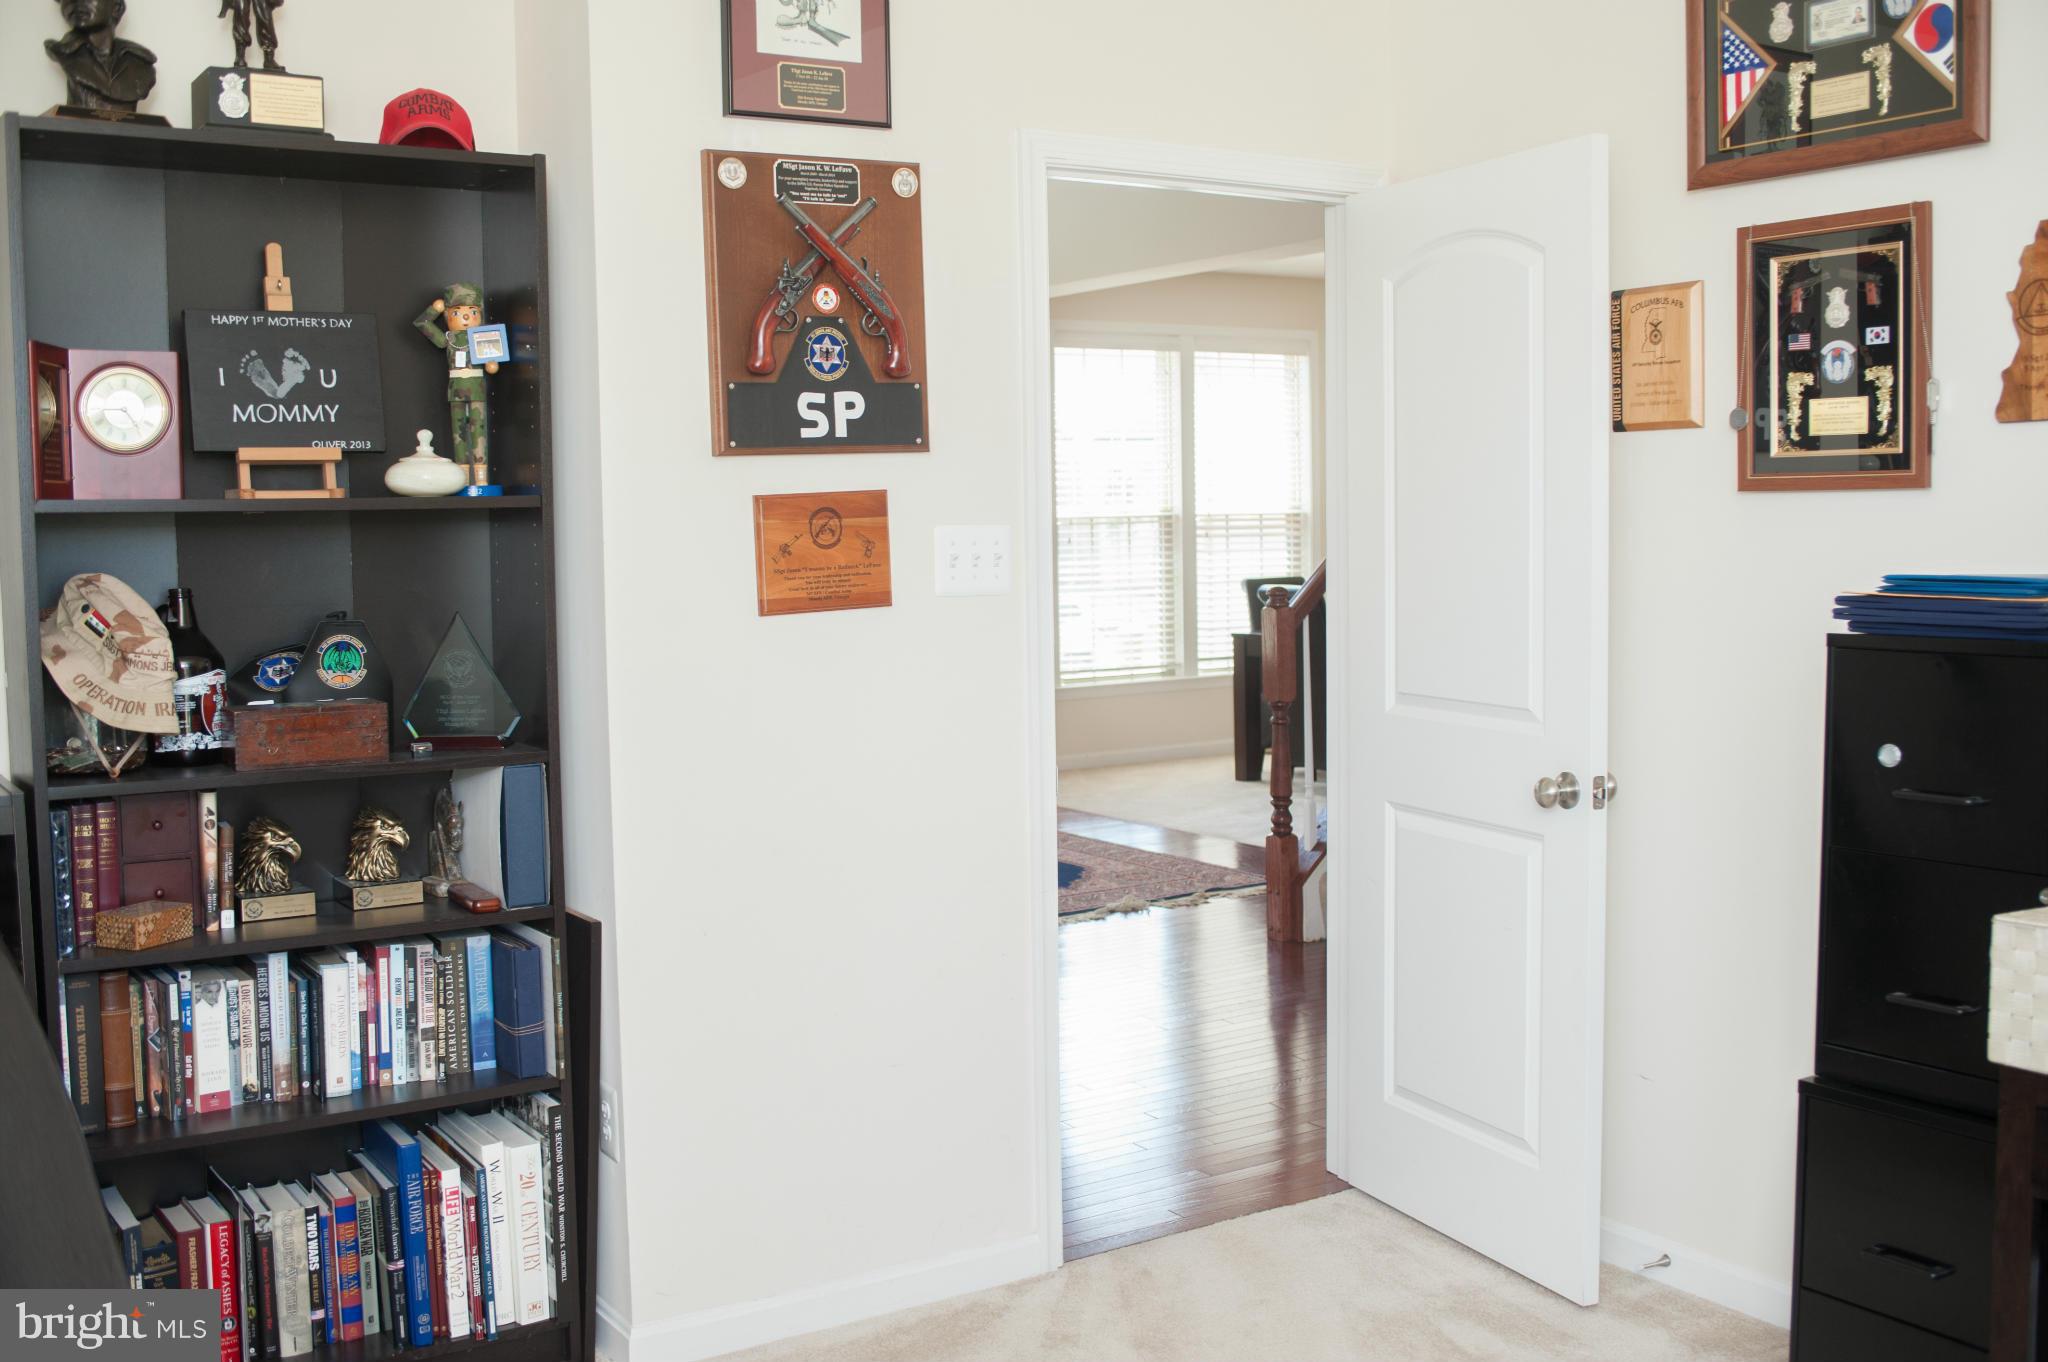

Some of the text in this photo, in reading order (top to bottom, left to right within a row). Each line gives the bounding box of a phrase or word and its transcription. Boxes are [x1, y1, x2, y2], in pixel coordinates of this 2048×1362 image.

[398, 93, 455, 112] COMBAT
[407, 104, 451, 121] ARMS
[798, 163, 816, 171] Jason
[1630, 297, 1670, 314] COLUMBUS
[211, 314, 353, 328] HAPPY 1ST MOTHER'S DAY
[1611, 298, 1622, 421] UNITED STATES AIR FORCE
[218, 367, 338, 389] I U
[232, 403, 340, 424] MOMMY
[797, 391, 866, 439] SP
[311, 440, 372, 449] OLIVER 2013
[102, 636, 121, 657] SSGT
[161, 662, 176, 673] JE
[72, 673, 146, 716] OPERATION
[425, 958, 433, 969] NOT
[425, 976, 433, 992] GOOD
[475, 950, 488, 1012] MATTERHORN
[228, 988, 240, 1041] GHOST SOLDIERS
[240, 984, 253, 1048] LONE SURVIVOR
[257, 968, 270, 1042] HEROES AMONG US
[426, 1006, 434, 1014] TO
[426, 1014, 434, 1024] DIE
[444, 954, 458, 1070] AMERICAN SOLDIER
[75, 1005, 90, 1105] THE WOODBOOK
[555, 1133, 563, 1163] SECOND
[407, 1180, 421, 1200] AIR
[556, 1164, 564, 1192] WORLD
[358, 1208, 372, 1240] KOREAN
[409, 1201, 423, 1234] FORCE
[558, 1214, 566, 1242] WINSTON
[306, 1214, 320, 1271] TWO WARS
[361, 1240, 373, 1257] WAR
[392, 1232, 400, 1260] America
[445, 1186, 465, 1300] LIFE World War 2
[483, 1226, 491, 1264] PHOTOGRAPHY
[520, 1201, 542, 1273] CENTURY
[218, 1225, 232, 1315] LEGACY of ASHES
[281, 1215, 298, 1319] COLDEST WINTER
[346, 1224, 358, 1296] TOM BROKAW
[472, 1255, 481, 1296] OPERATORS
